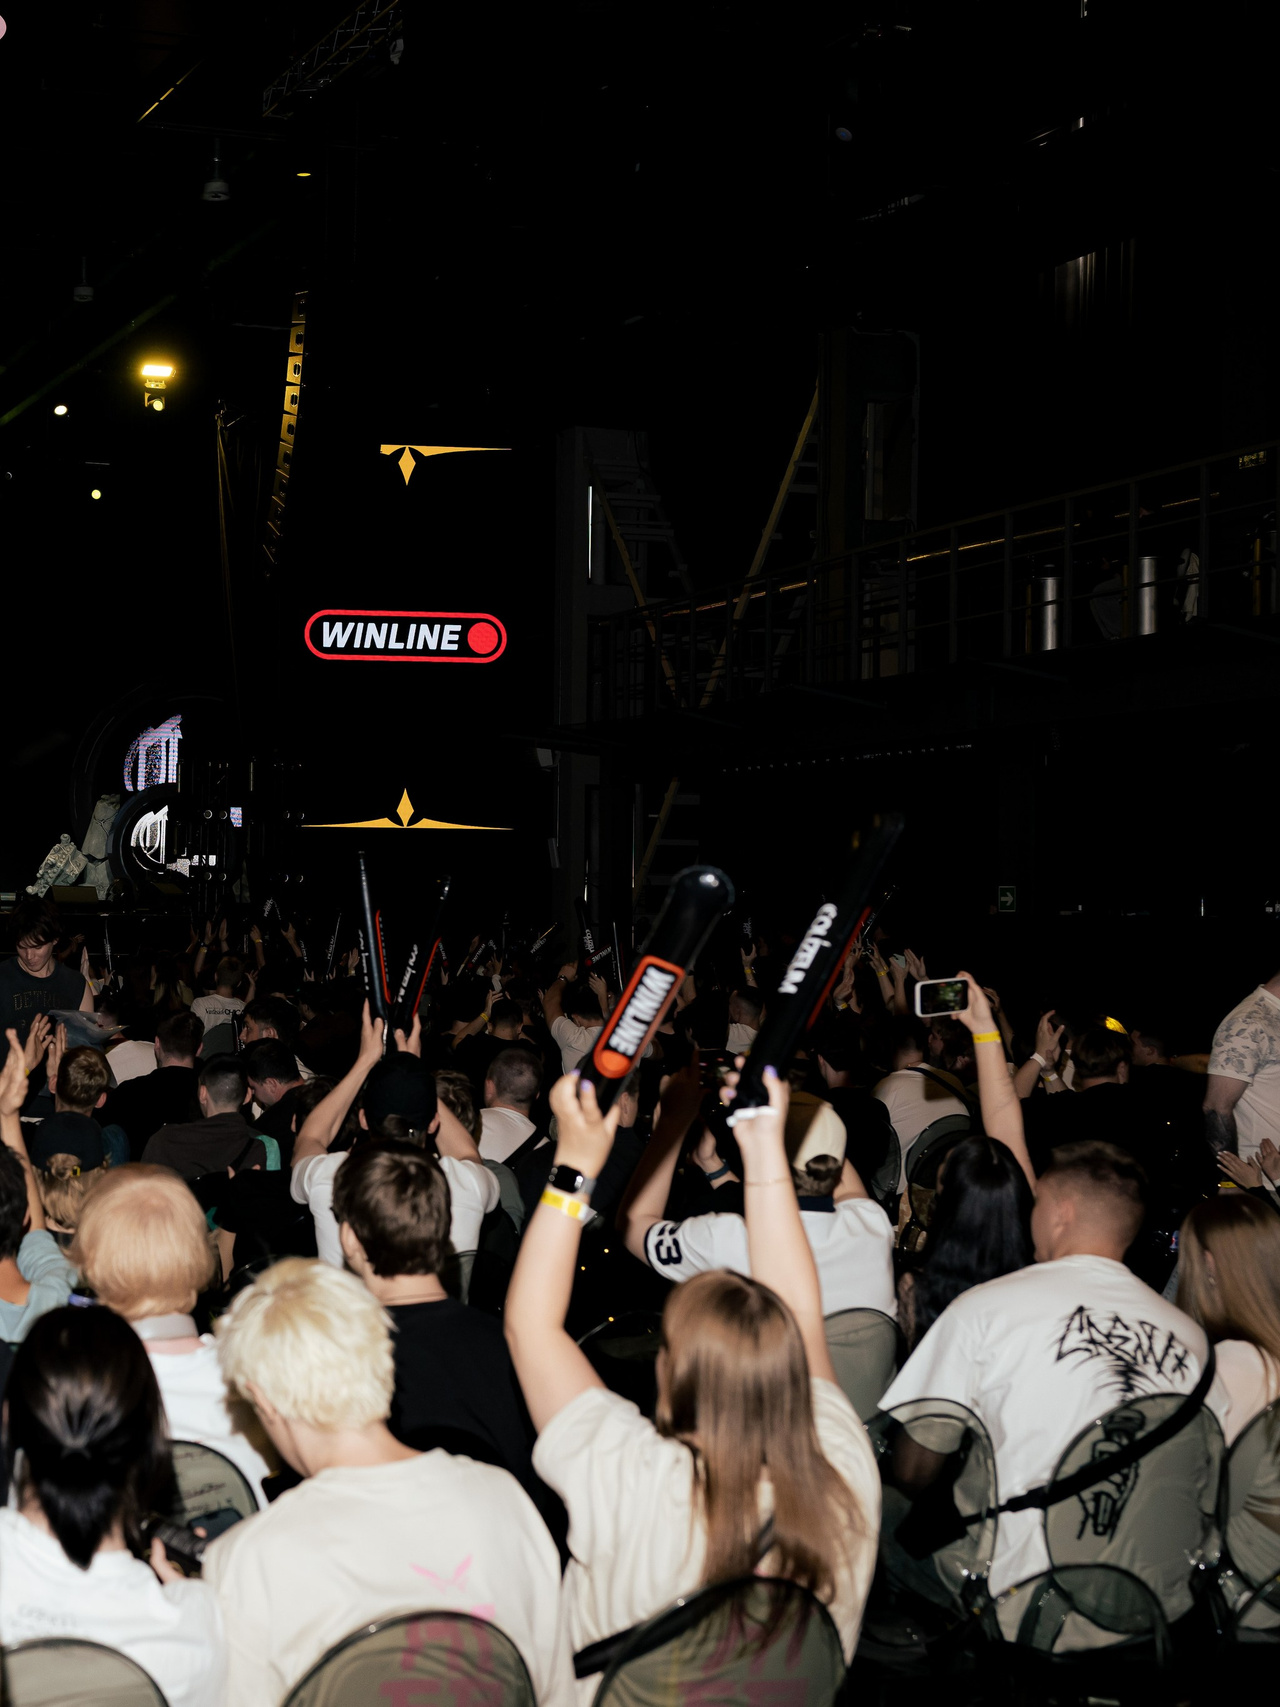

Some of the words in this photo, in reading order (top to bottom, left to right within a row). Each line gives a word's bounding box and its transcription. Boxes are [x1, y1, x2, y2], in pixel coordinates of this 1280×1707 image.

[323, 621, 462, 650] WINLINE
[777, 902, 838, 995] COLIZEUM
[608, 964, 677, 1057] WINLINE
